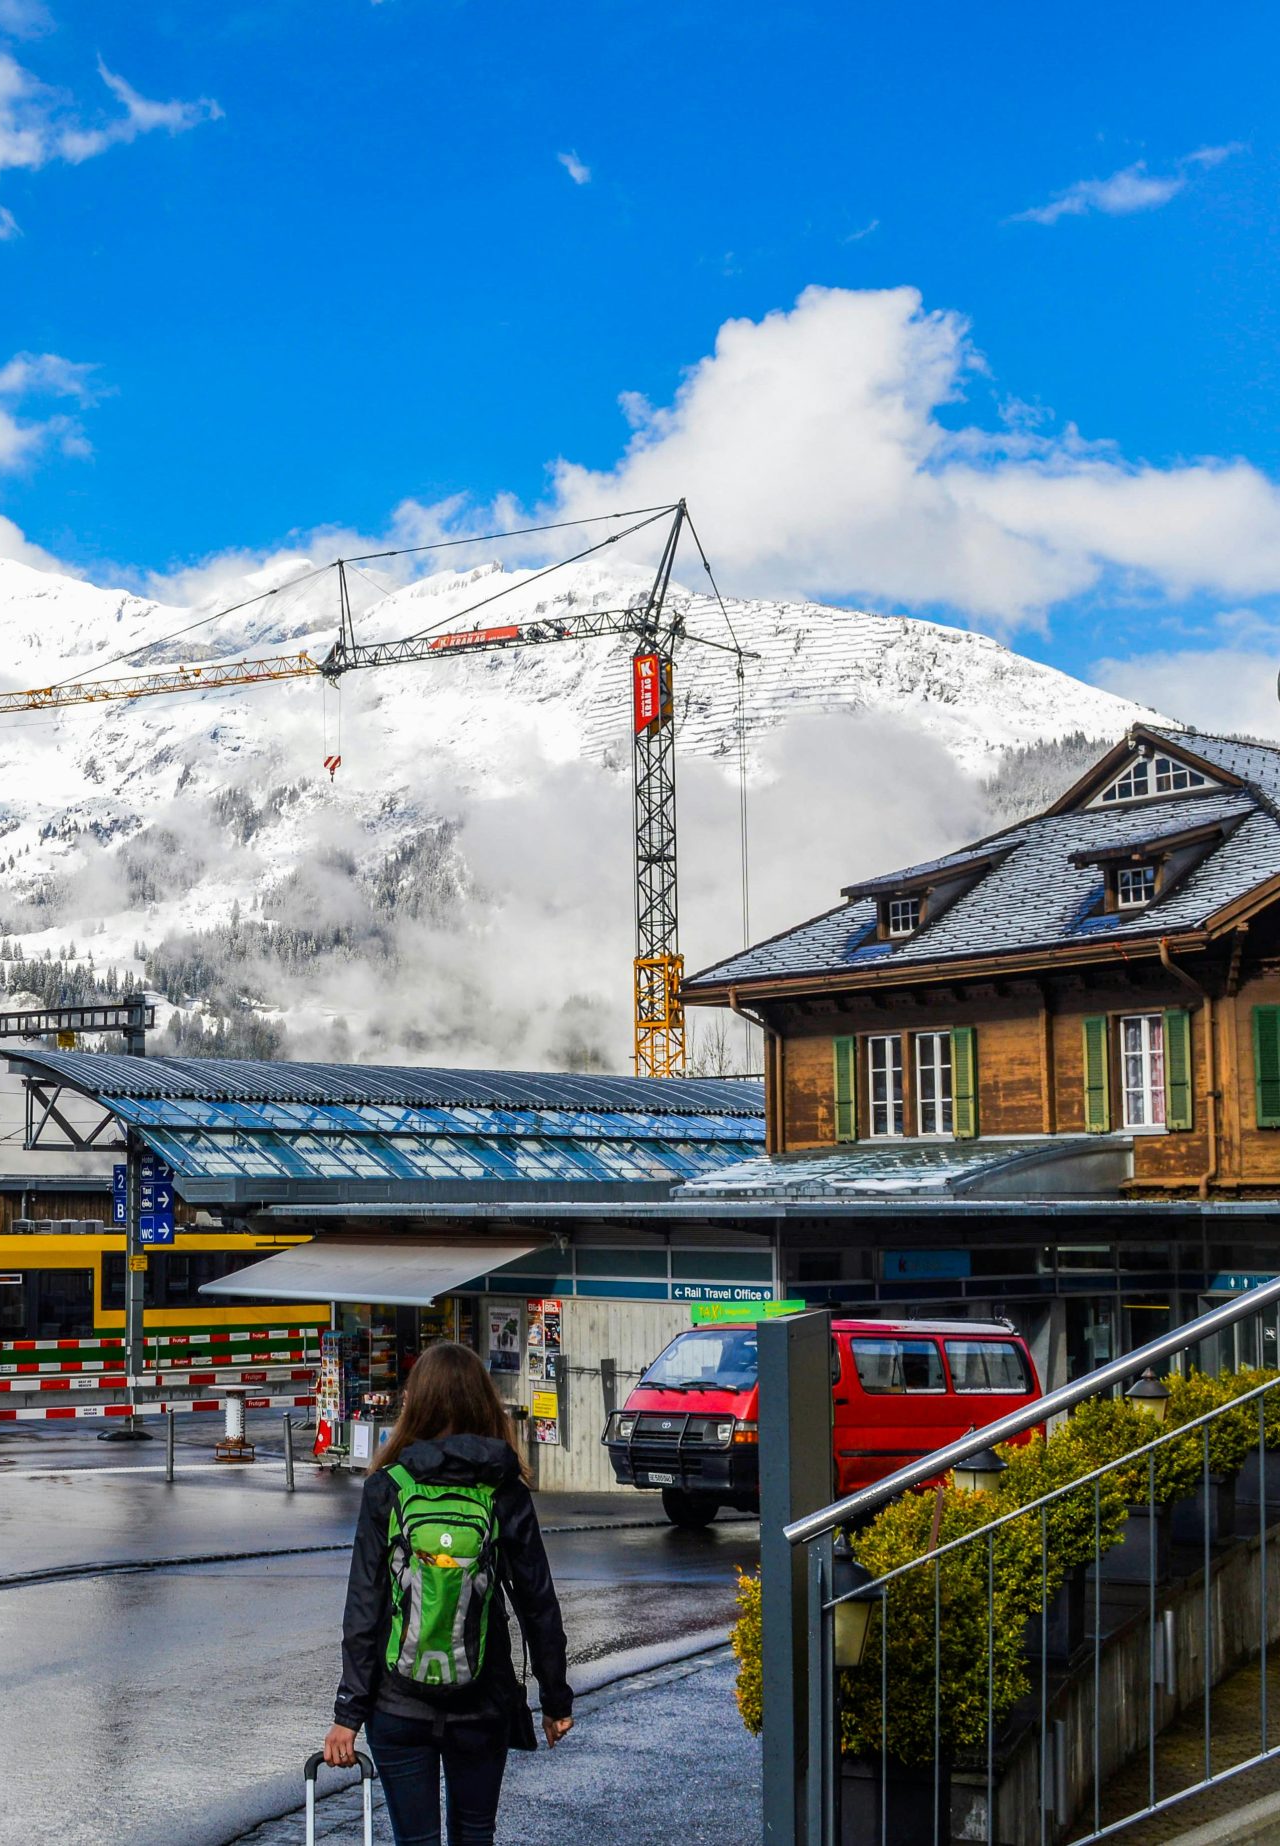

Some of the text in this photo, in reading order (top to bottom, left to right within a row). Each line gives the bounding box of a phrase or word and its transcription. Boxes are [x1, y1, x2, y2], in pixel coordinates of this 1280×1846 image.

[449, 636, 473, 646] KRAN
[475, 634, 486, 642] AG
[644, 678, 652, 717] KRAN AG
[117, 1174, 124, 1189] 2
[117, 1203, 124, 1218] B
[141, 1228, 153, 1240] WC
[684, 1286, 762, 1300] Rail Travel Office
[527, 1302, 542, 1312] Blick
[544, 1303, 561, 1313] Blick
[248, 1399, 266, 1407] Frutiger
